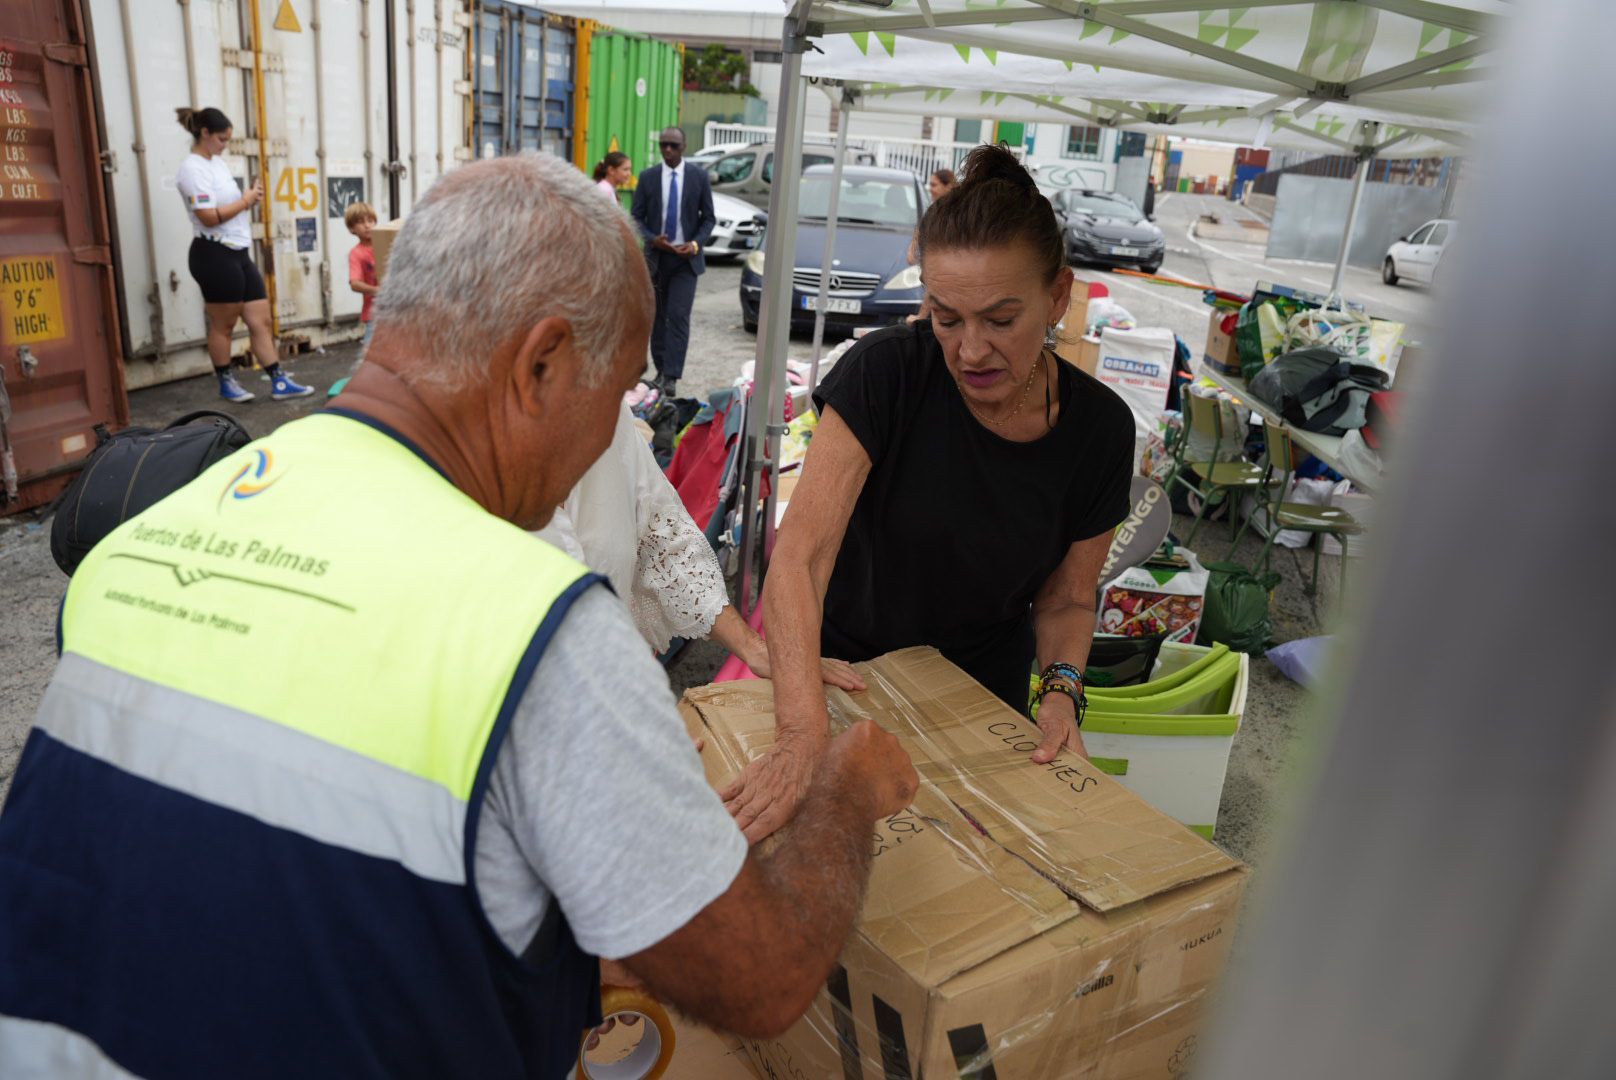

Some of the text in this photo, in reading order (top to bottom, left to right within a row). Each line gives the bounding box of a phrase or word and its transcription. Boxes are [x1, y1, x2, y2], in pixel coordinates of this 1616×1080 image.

[275, 166, 319, 212] 45
[2, 261, 55, 284] AUTION
[14, 313, 48, 336] HIGH
[130, 522, 330, 576] Puertos de Las Palmas
[988, 722, 1097, 793] CLOHES
